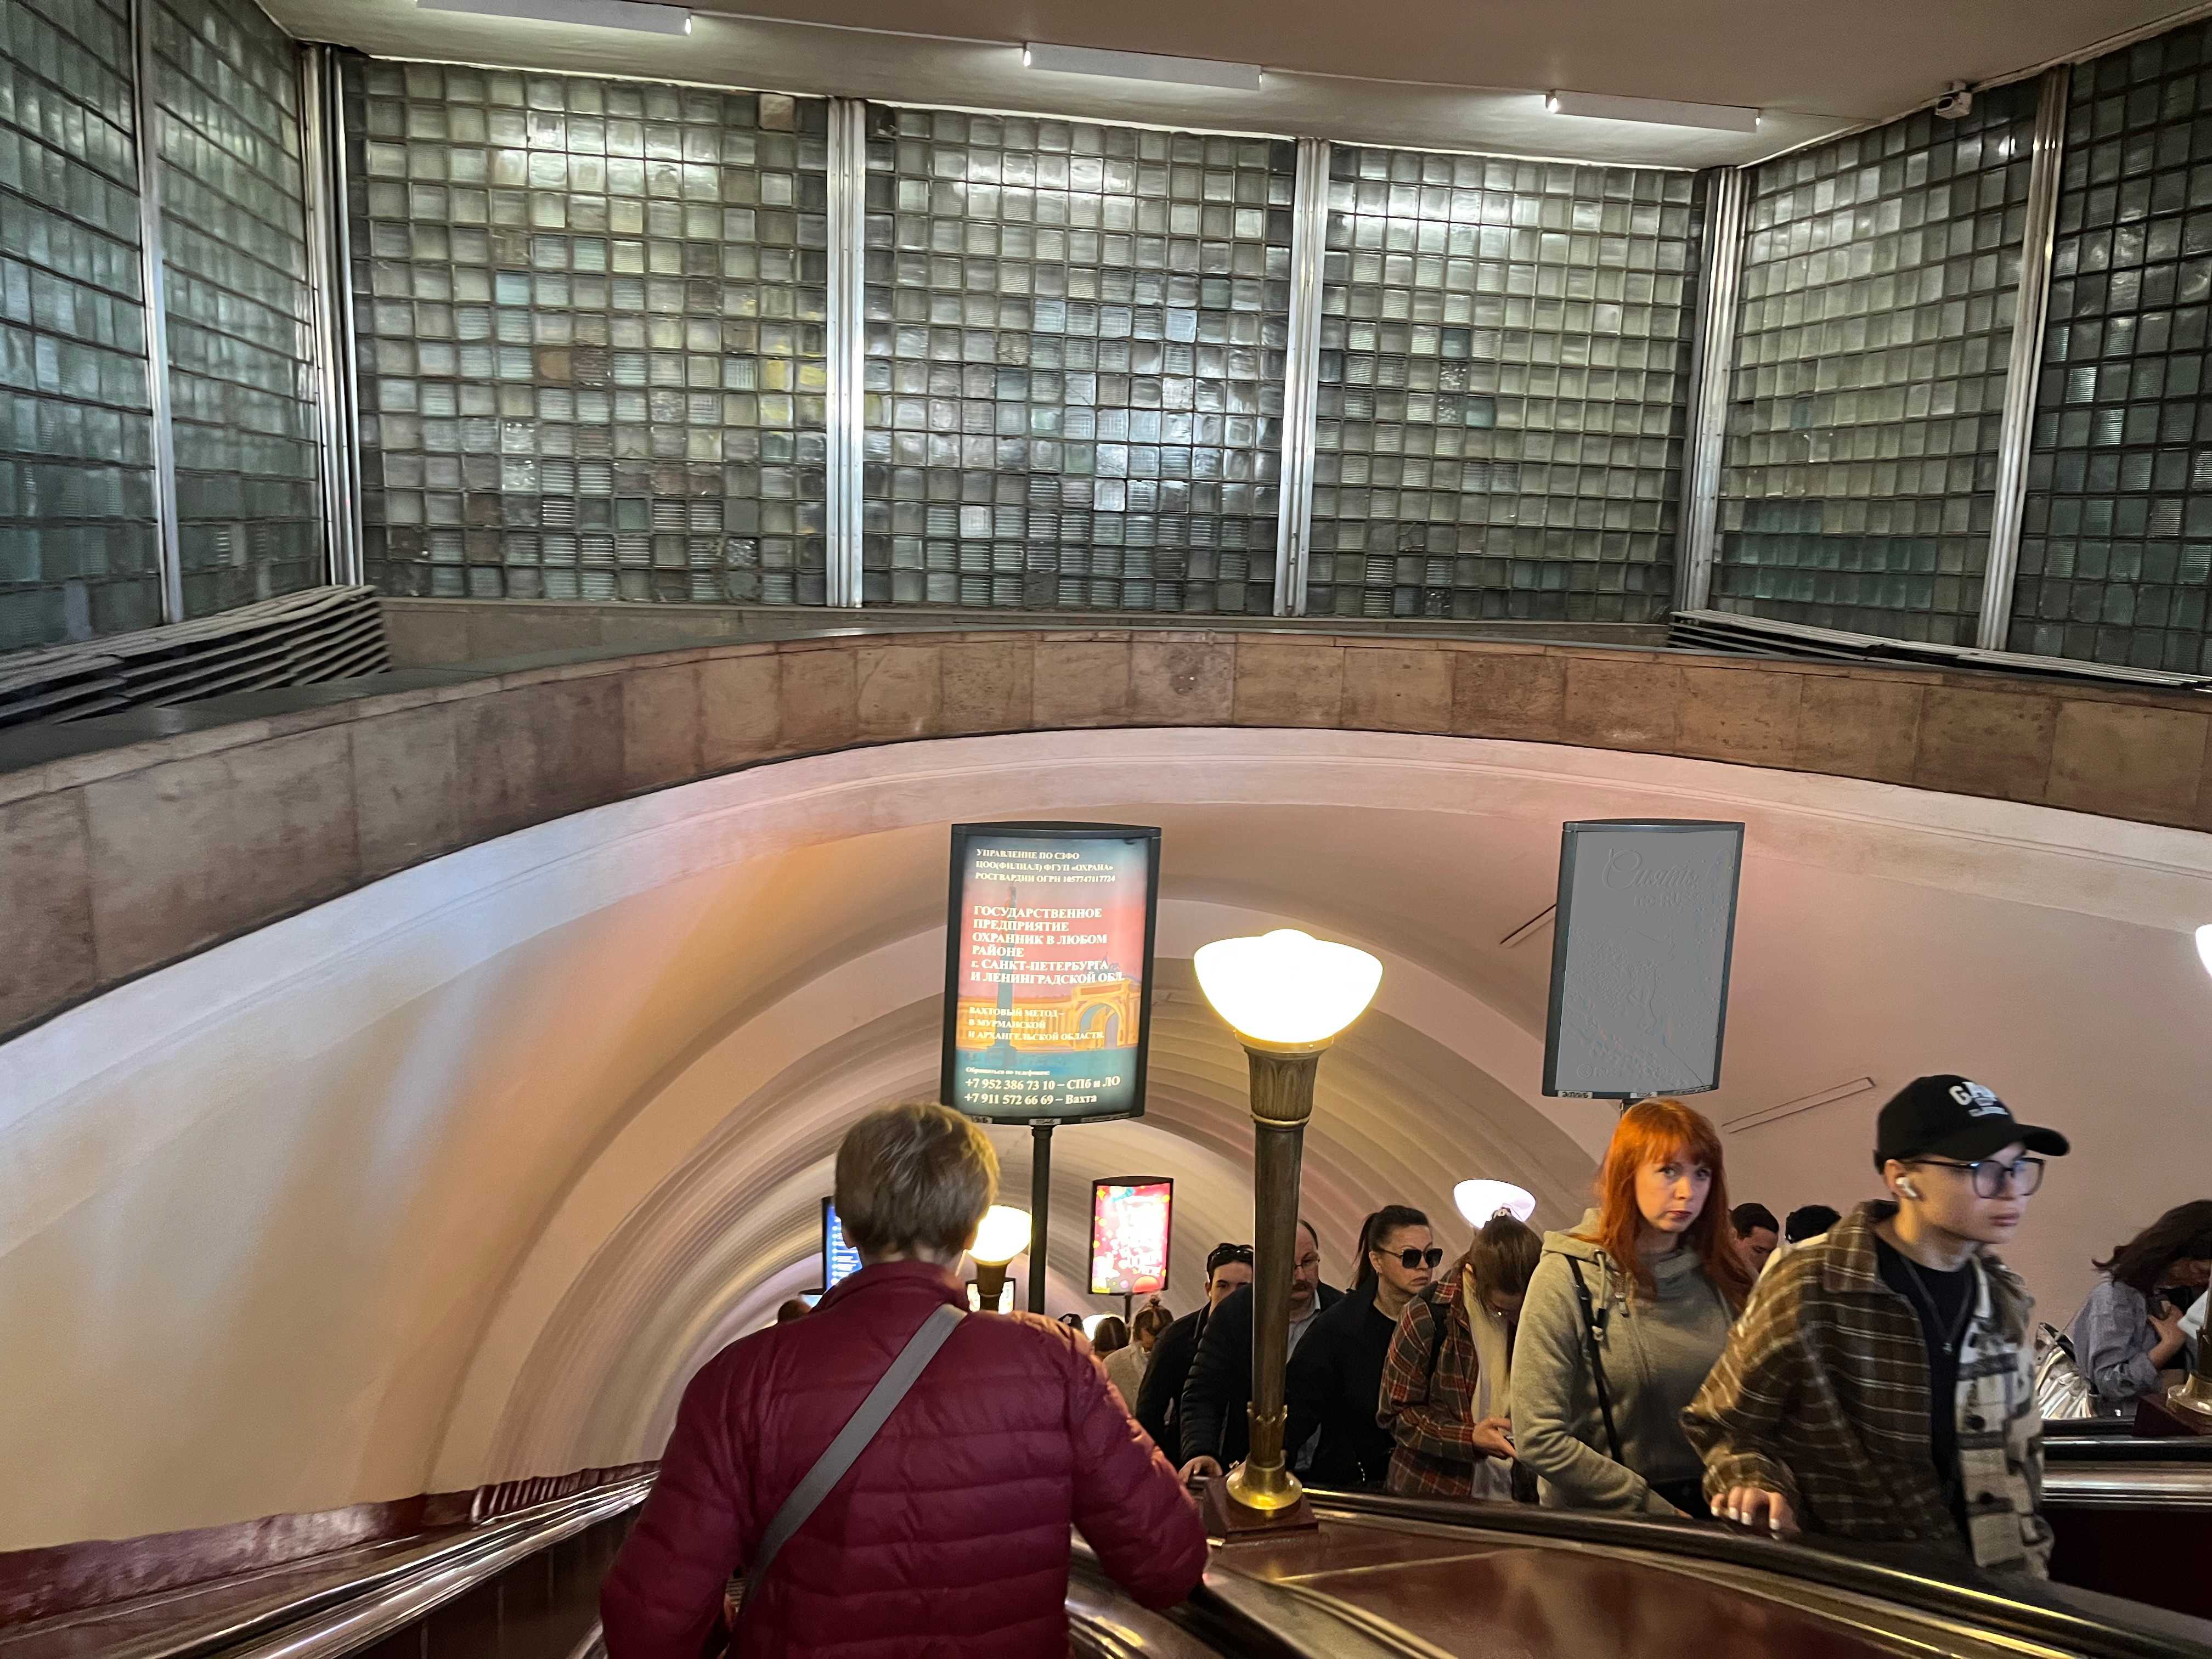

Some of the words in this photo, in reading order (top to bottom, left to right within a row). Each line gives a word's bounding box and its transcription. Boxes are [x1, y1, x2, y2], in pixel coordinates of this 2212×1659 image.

[977, 848, 1037, 859] УПРАВЛЕНИЕ
[1039, 851, 1053, 860] ПО
[975, 872, 1035, 882] РОСГВАРДИИ
[974, 905, 1103, 919] ГОСУДАРСТВЕННОЕ
[973, 918, 1069, 932] ПРЕДПРИЯТИЕ
[972, 932, 1044, 945] ОХРАННИК
[1046, 935, 1055, 944] В
[1057, 934, 1108, 945] ЛЮБОМ
[972, 944, 1025, 957] РАЙОНЕ
[981, 959, 1109, 972] САНКТ-ПЕТЕРБУРГА
[970, 972, 981, 981] И
[983, 972, 1096, 985] ЛЕНИНГРАДСКОЙ
[969, 1007, 1022, 1017] ВАХТОВЫЙ
[1025, 1009, 1057, 1018] МЕТОД
[976, 1019, 1046, 1029] МУРМАНСКОЙ
[978, 1031, 1059, 1041] АРХАНГЕЛЬСКОЙ
[966, 1066, 1005, 1075] Обрться
[966, 1078, 980, 1088] +7
[982, 1079, 1002, 1089] 952
[1003, 1080, 1024, 1090] 386
[1026, 1080, 1040, 1091] 73
[1042, 1081, 1056, 1090] 10
[1066, 1079, 1092, 1090] СПб
[1102, 1076, 1121, 1088] ЛО
[964, 1093, 980, 1104] +7
[981, 1093, 1000, 1104] 911
[1002, 1094, 1023, 1105] 572
[1024, 1095, 1039, 1105] 66
[1040, 1095, 1054, 1105] 69
[1065, 1094, 1097, 1104] Вахта
